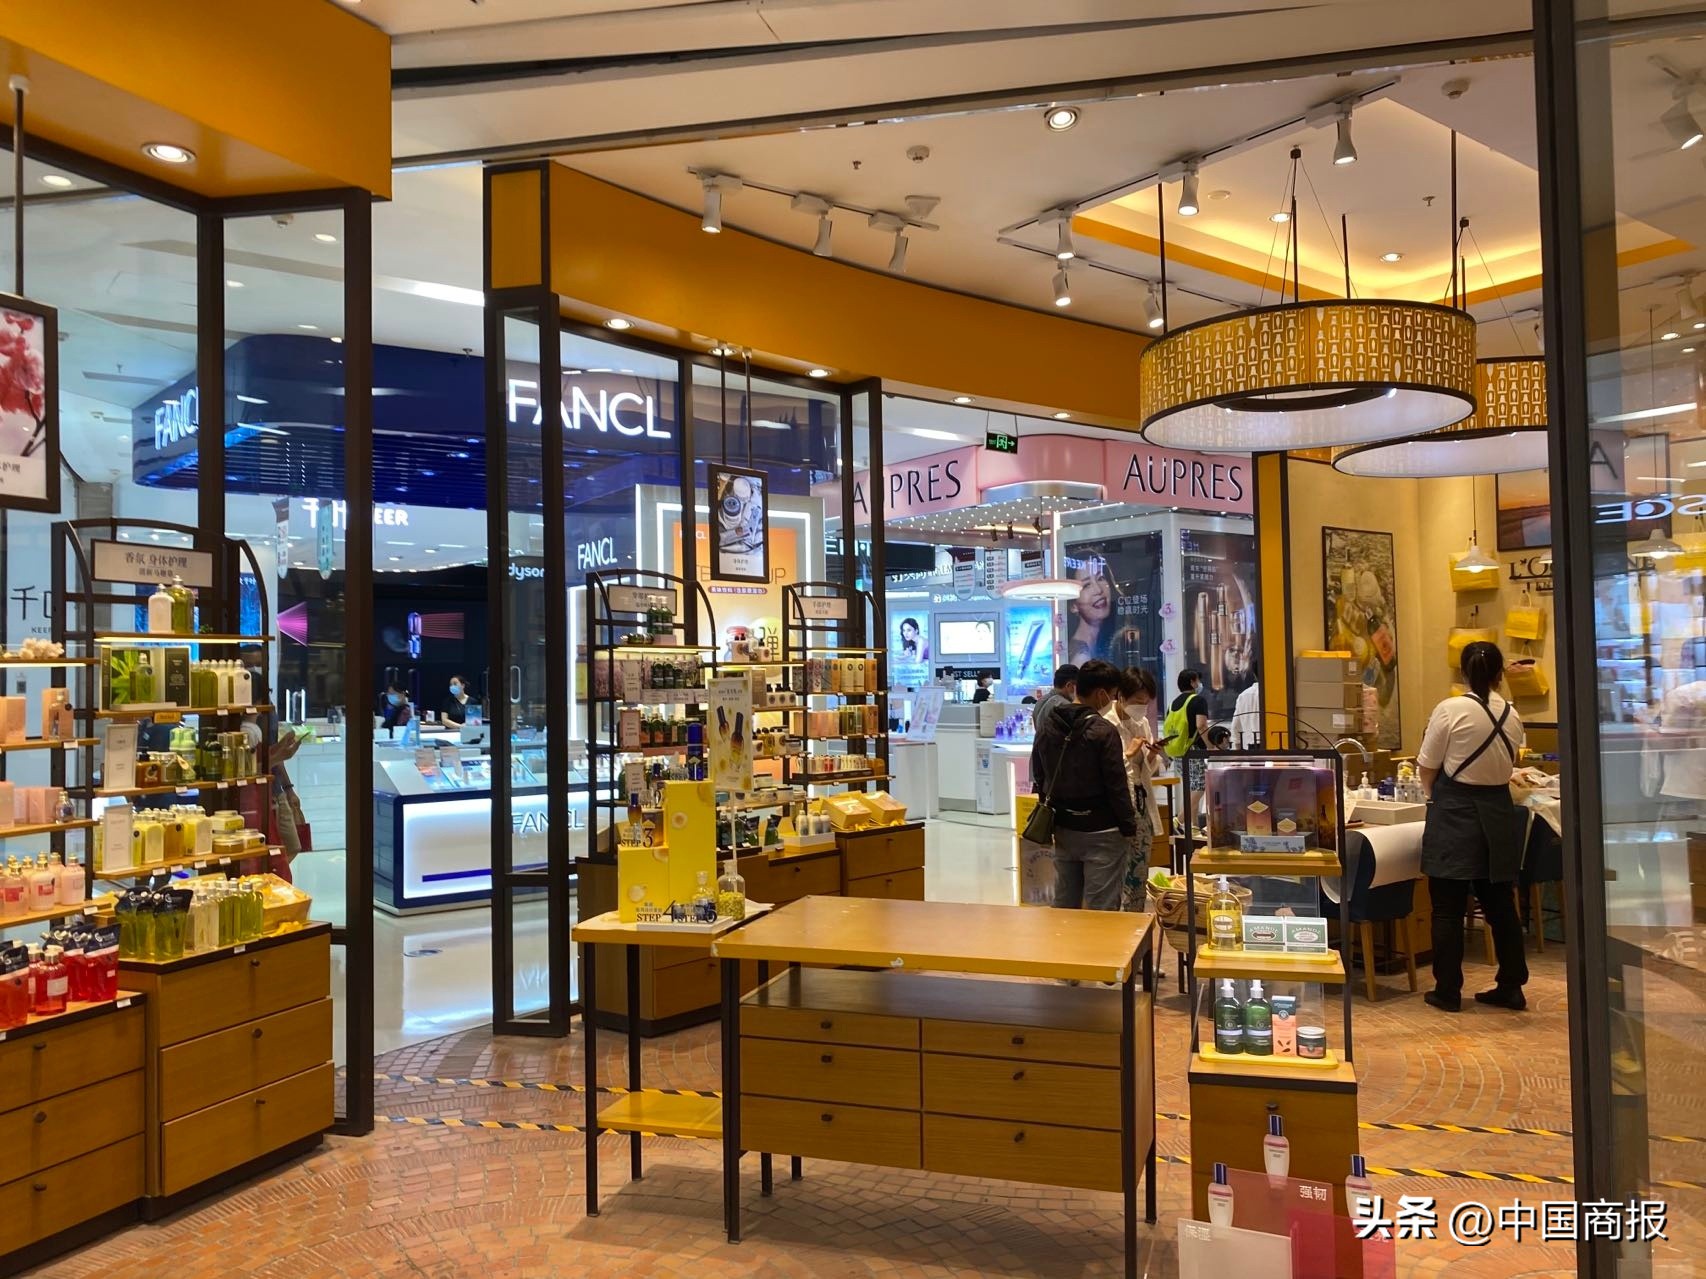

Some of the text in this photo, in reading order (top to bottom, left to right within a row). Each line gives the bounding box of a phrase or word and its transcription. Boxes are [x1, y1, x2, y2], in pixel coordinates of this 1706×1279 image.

[853, 460, 961, 515] APRES
[577, 537, 618, 570] FANCL
[643, 827, 653, 848] 3
[636, 913, 662, 922] STEP
